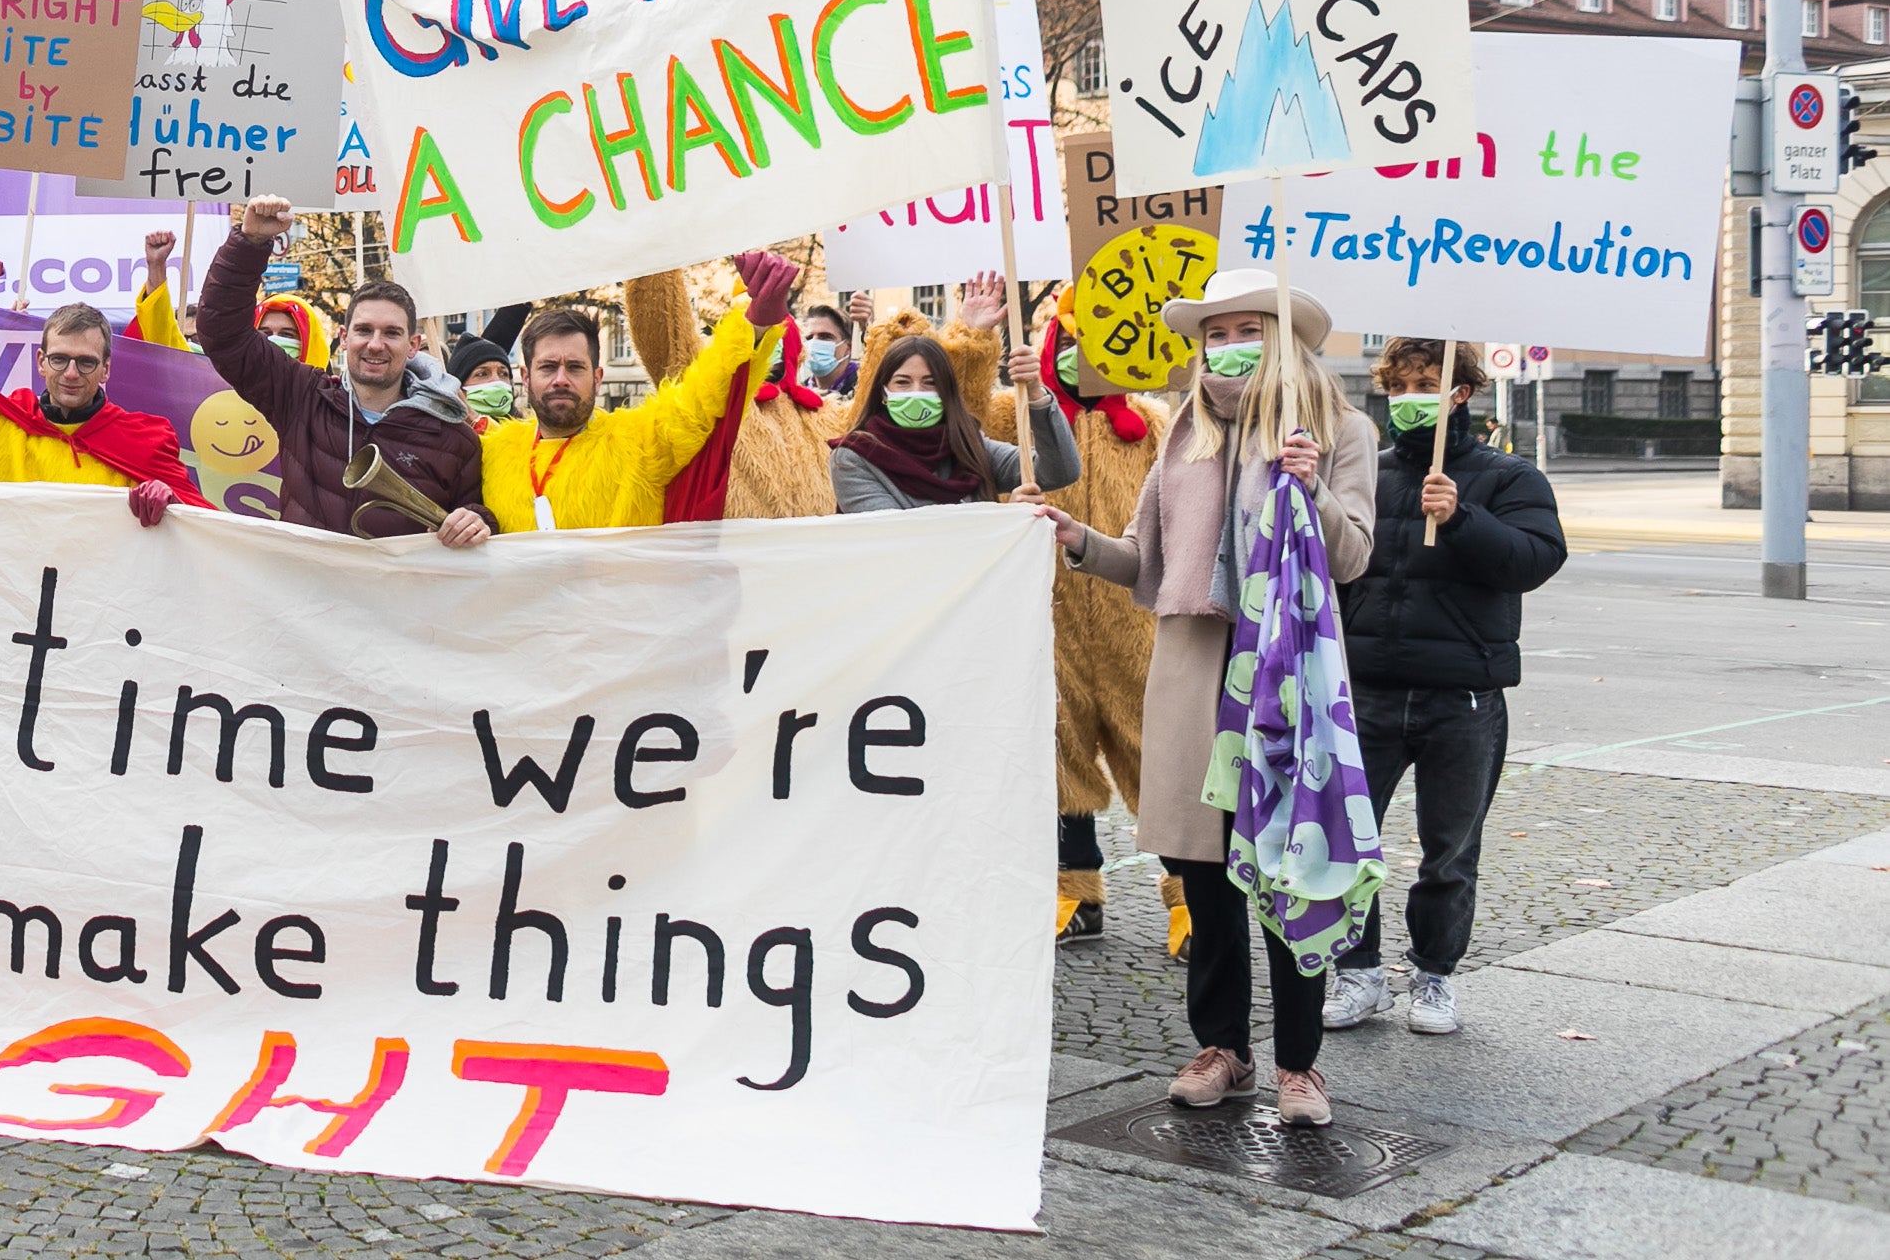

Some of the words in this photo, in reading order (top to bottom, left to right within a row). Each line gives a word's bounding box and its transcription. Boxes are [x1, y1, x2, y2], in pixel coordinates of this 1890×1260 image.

[19, 70, 60, 111] by
[134, 65, 209, 92] asst
[232, 63, 292, 101] die
[139, 147, 254, 197] frei
[1537, 130, 1642, 181] the
[1784, 145, 1828, 161] ganzer
[1790, 164, 1822, 180] Platz
[393, 125, 483, 255] A
[1096, 185, 1224, 227] RIGH
[1244, 204, 1693, 286] #TastyRevolution
[1145, 292, 1185, 315] b
[12, 566, 379, 794] time
[473, 648, 927, 814] we're
[405, 839, 927, 1091] things
